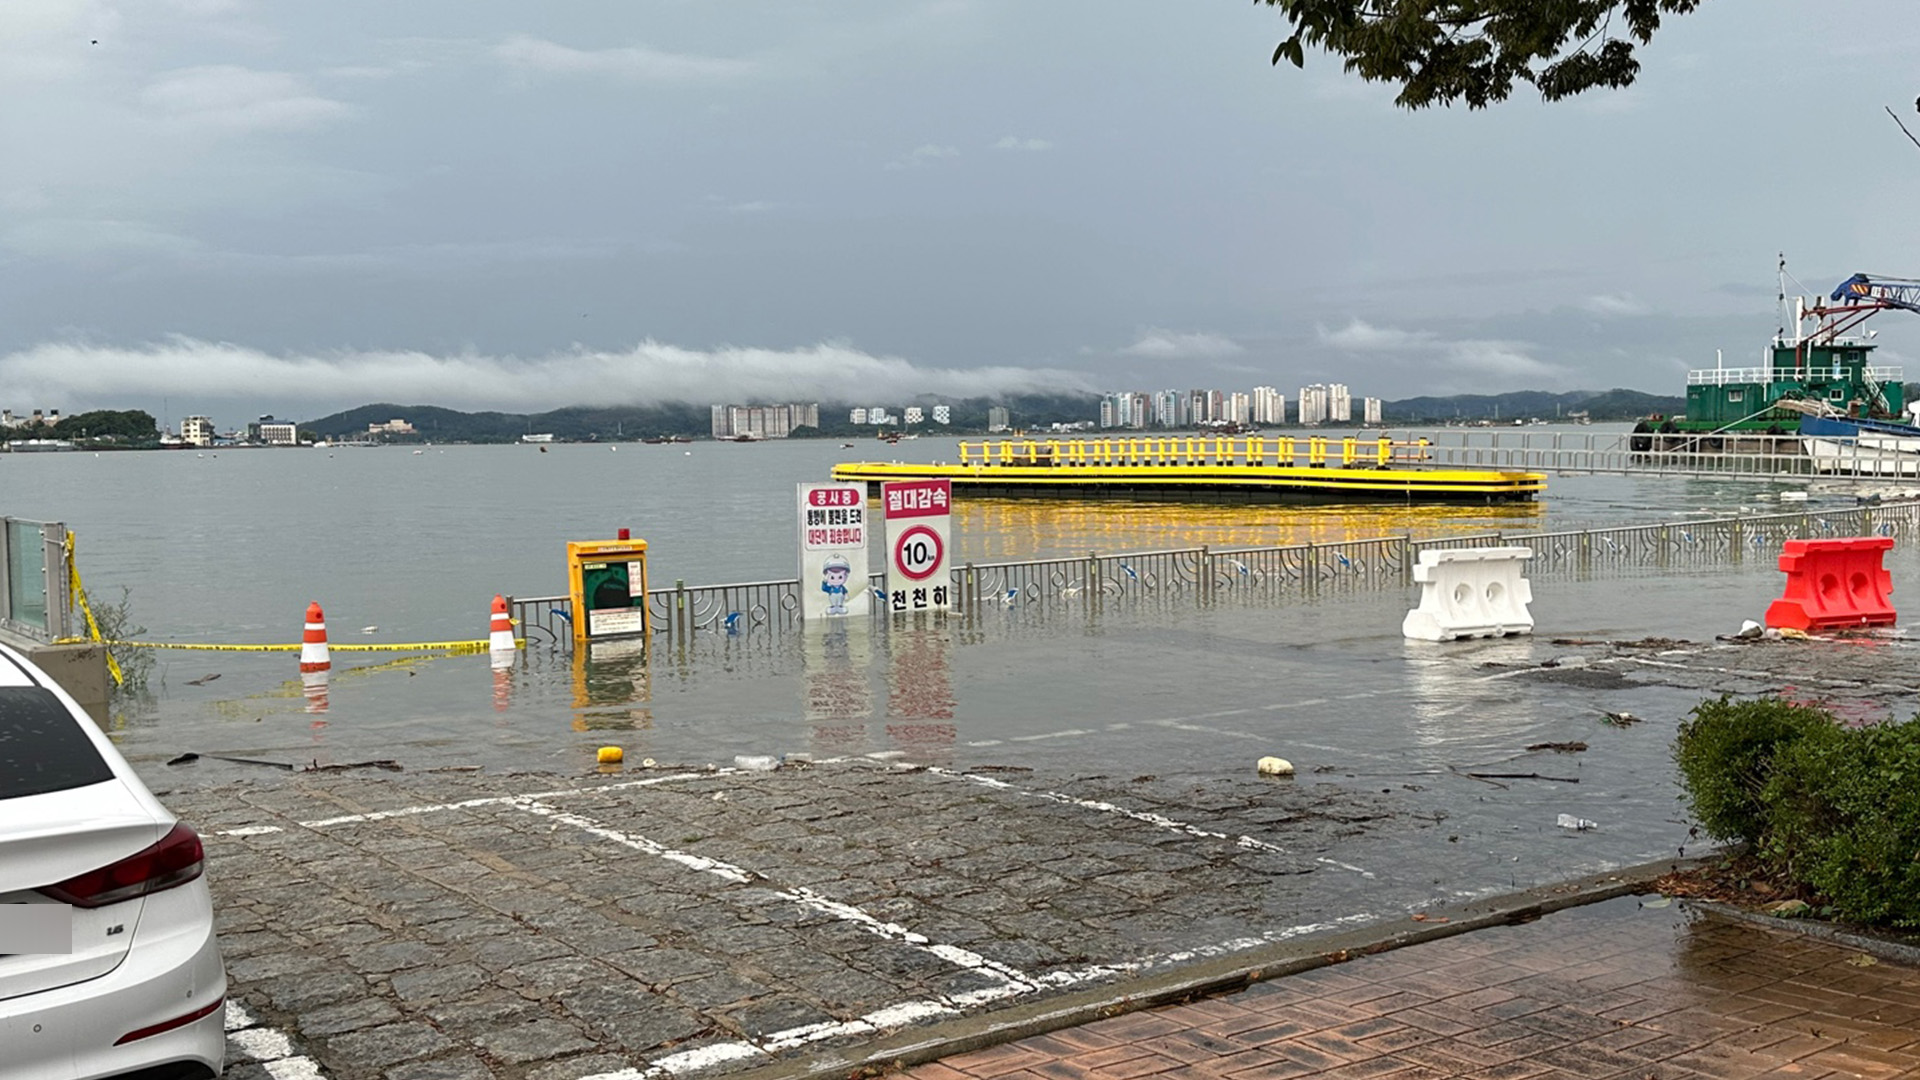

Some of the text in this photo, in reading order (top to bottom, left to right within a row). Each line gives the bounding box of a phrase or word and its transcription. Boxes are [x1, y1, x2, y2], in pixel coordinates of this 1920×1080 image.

[817, 490, 851, 505] 공사중
[888, 487, 947, 511] 절대감속
[828, 508, 848, 525] 불편을
[850, 508, 861, 524] 드려
[808, 528, 861, 545] 대단히 죄송합니다
[892, 586, 947, 611] 천천히
